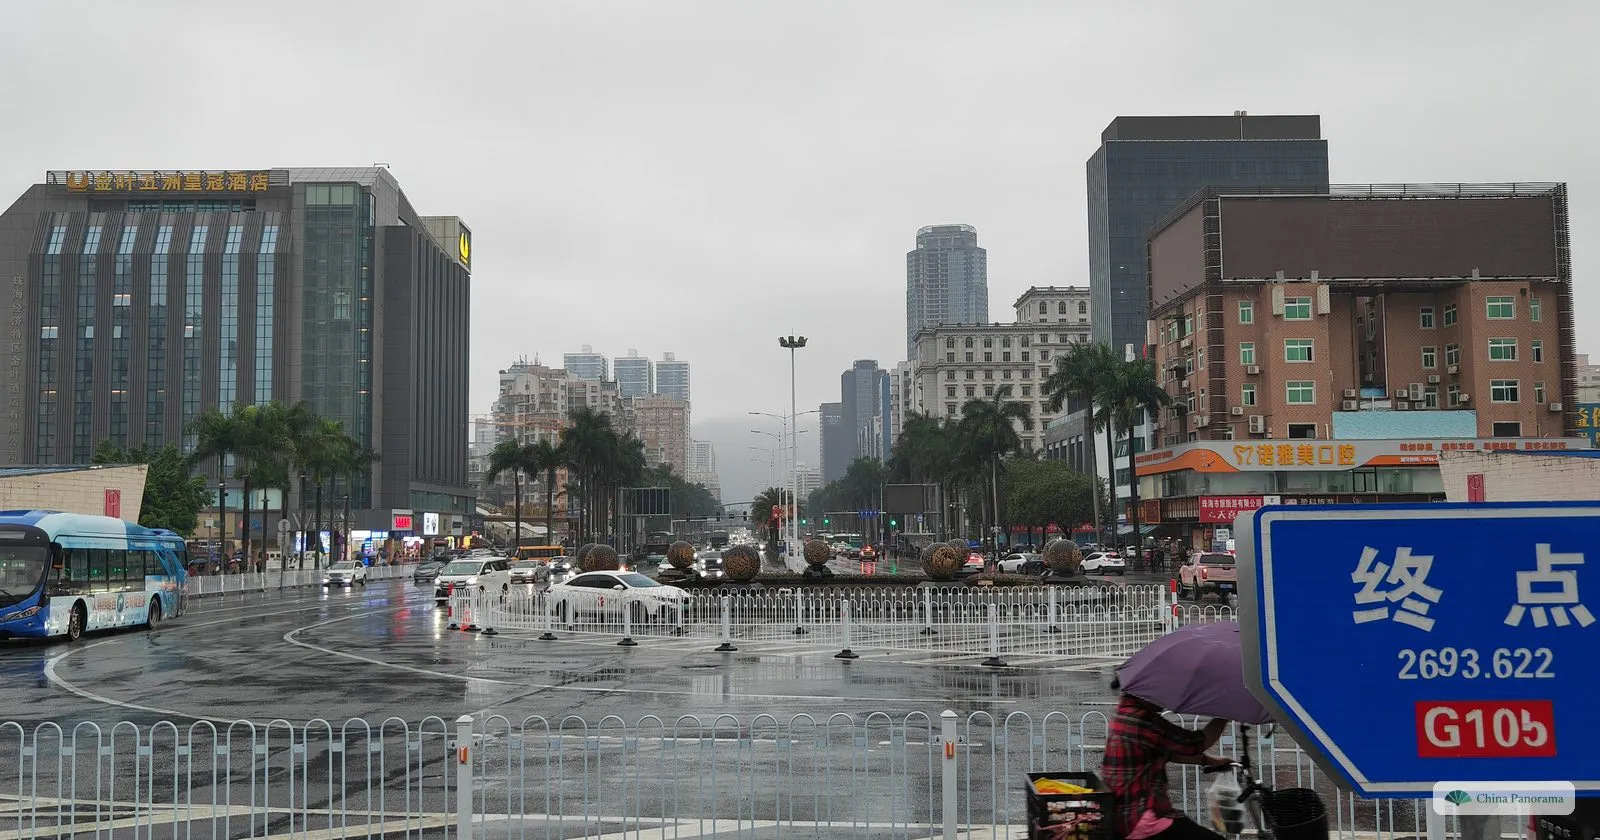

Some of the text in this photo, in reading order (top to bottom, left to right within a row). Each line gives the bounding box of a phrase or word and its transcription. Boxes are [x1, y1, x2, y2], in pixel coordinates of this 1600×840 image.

[94, 172, 269, 191] 金叶五洲皇冠酒店
[1256, 444, 1355, 465] 诺雅美口腔
[1351, 543, 1596, 632] 终点
[1397, 647, 1555, 680] 2693.622
[1423, 706, 1548, 749] G105
